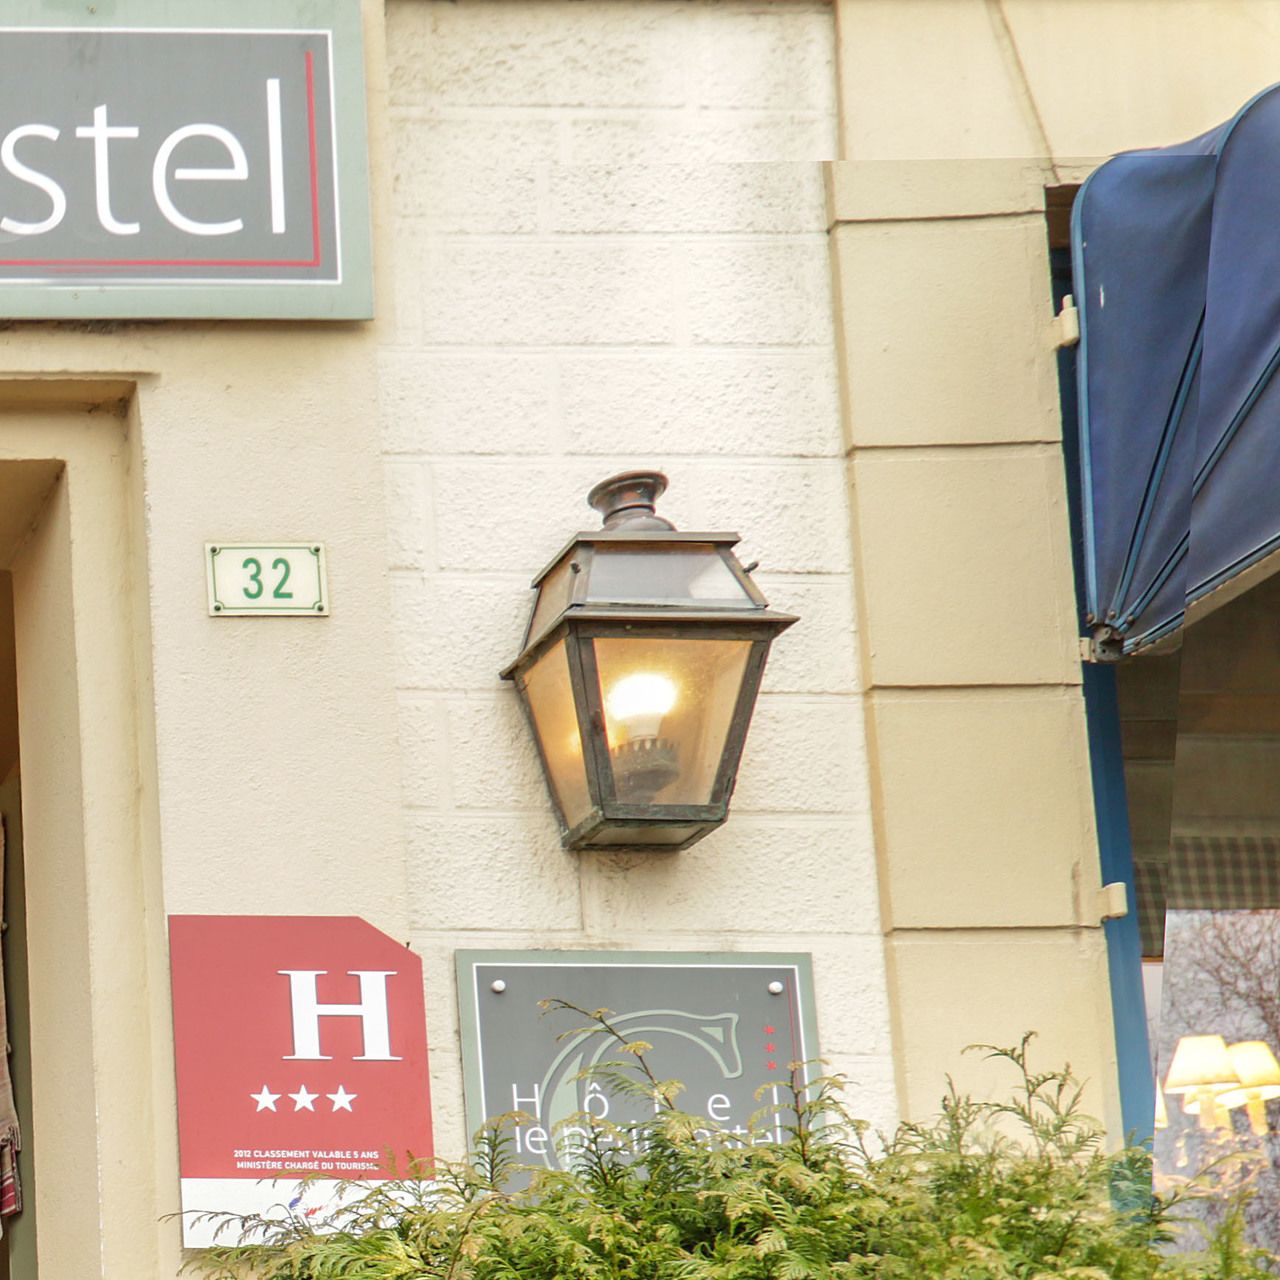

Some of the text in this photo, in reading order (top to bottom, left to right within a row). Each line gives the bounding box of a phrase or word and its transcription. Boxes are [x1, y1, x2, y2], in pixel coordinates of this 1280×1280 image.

[242, 557, 293, 600] 32
[276, 969, 403, 1061] H
[511, 1082, 782, 1126] Hôel
[233, 1149, 379, 1159] 2012 CLASSEMENT VALABLE 5 ANS
[236, 1160, 283, 1170] MINISTÈRE
[284, 1160, 319, 1170] CHARGÉ
[321, 1161, 334, 1170] DU
